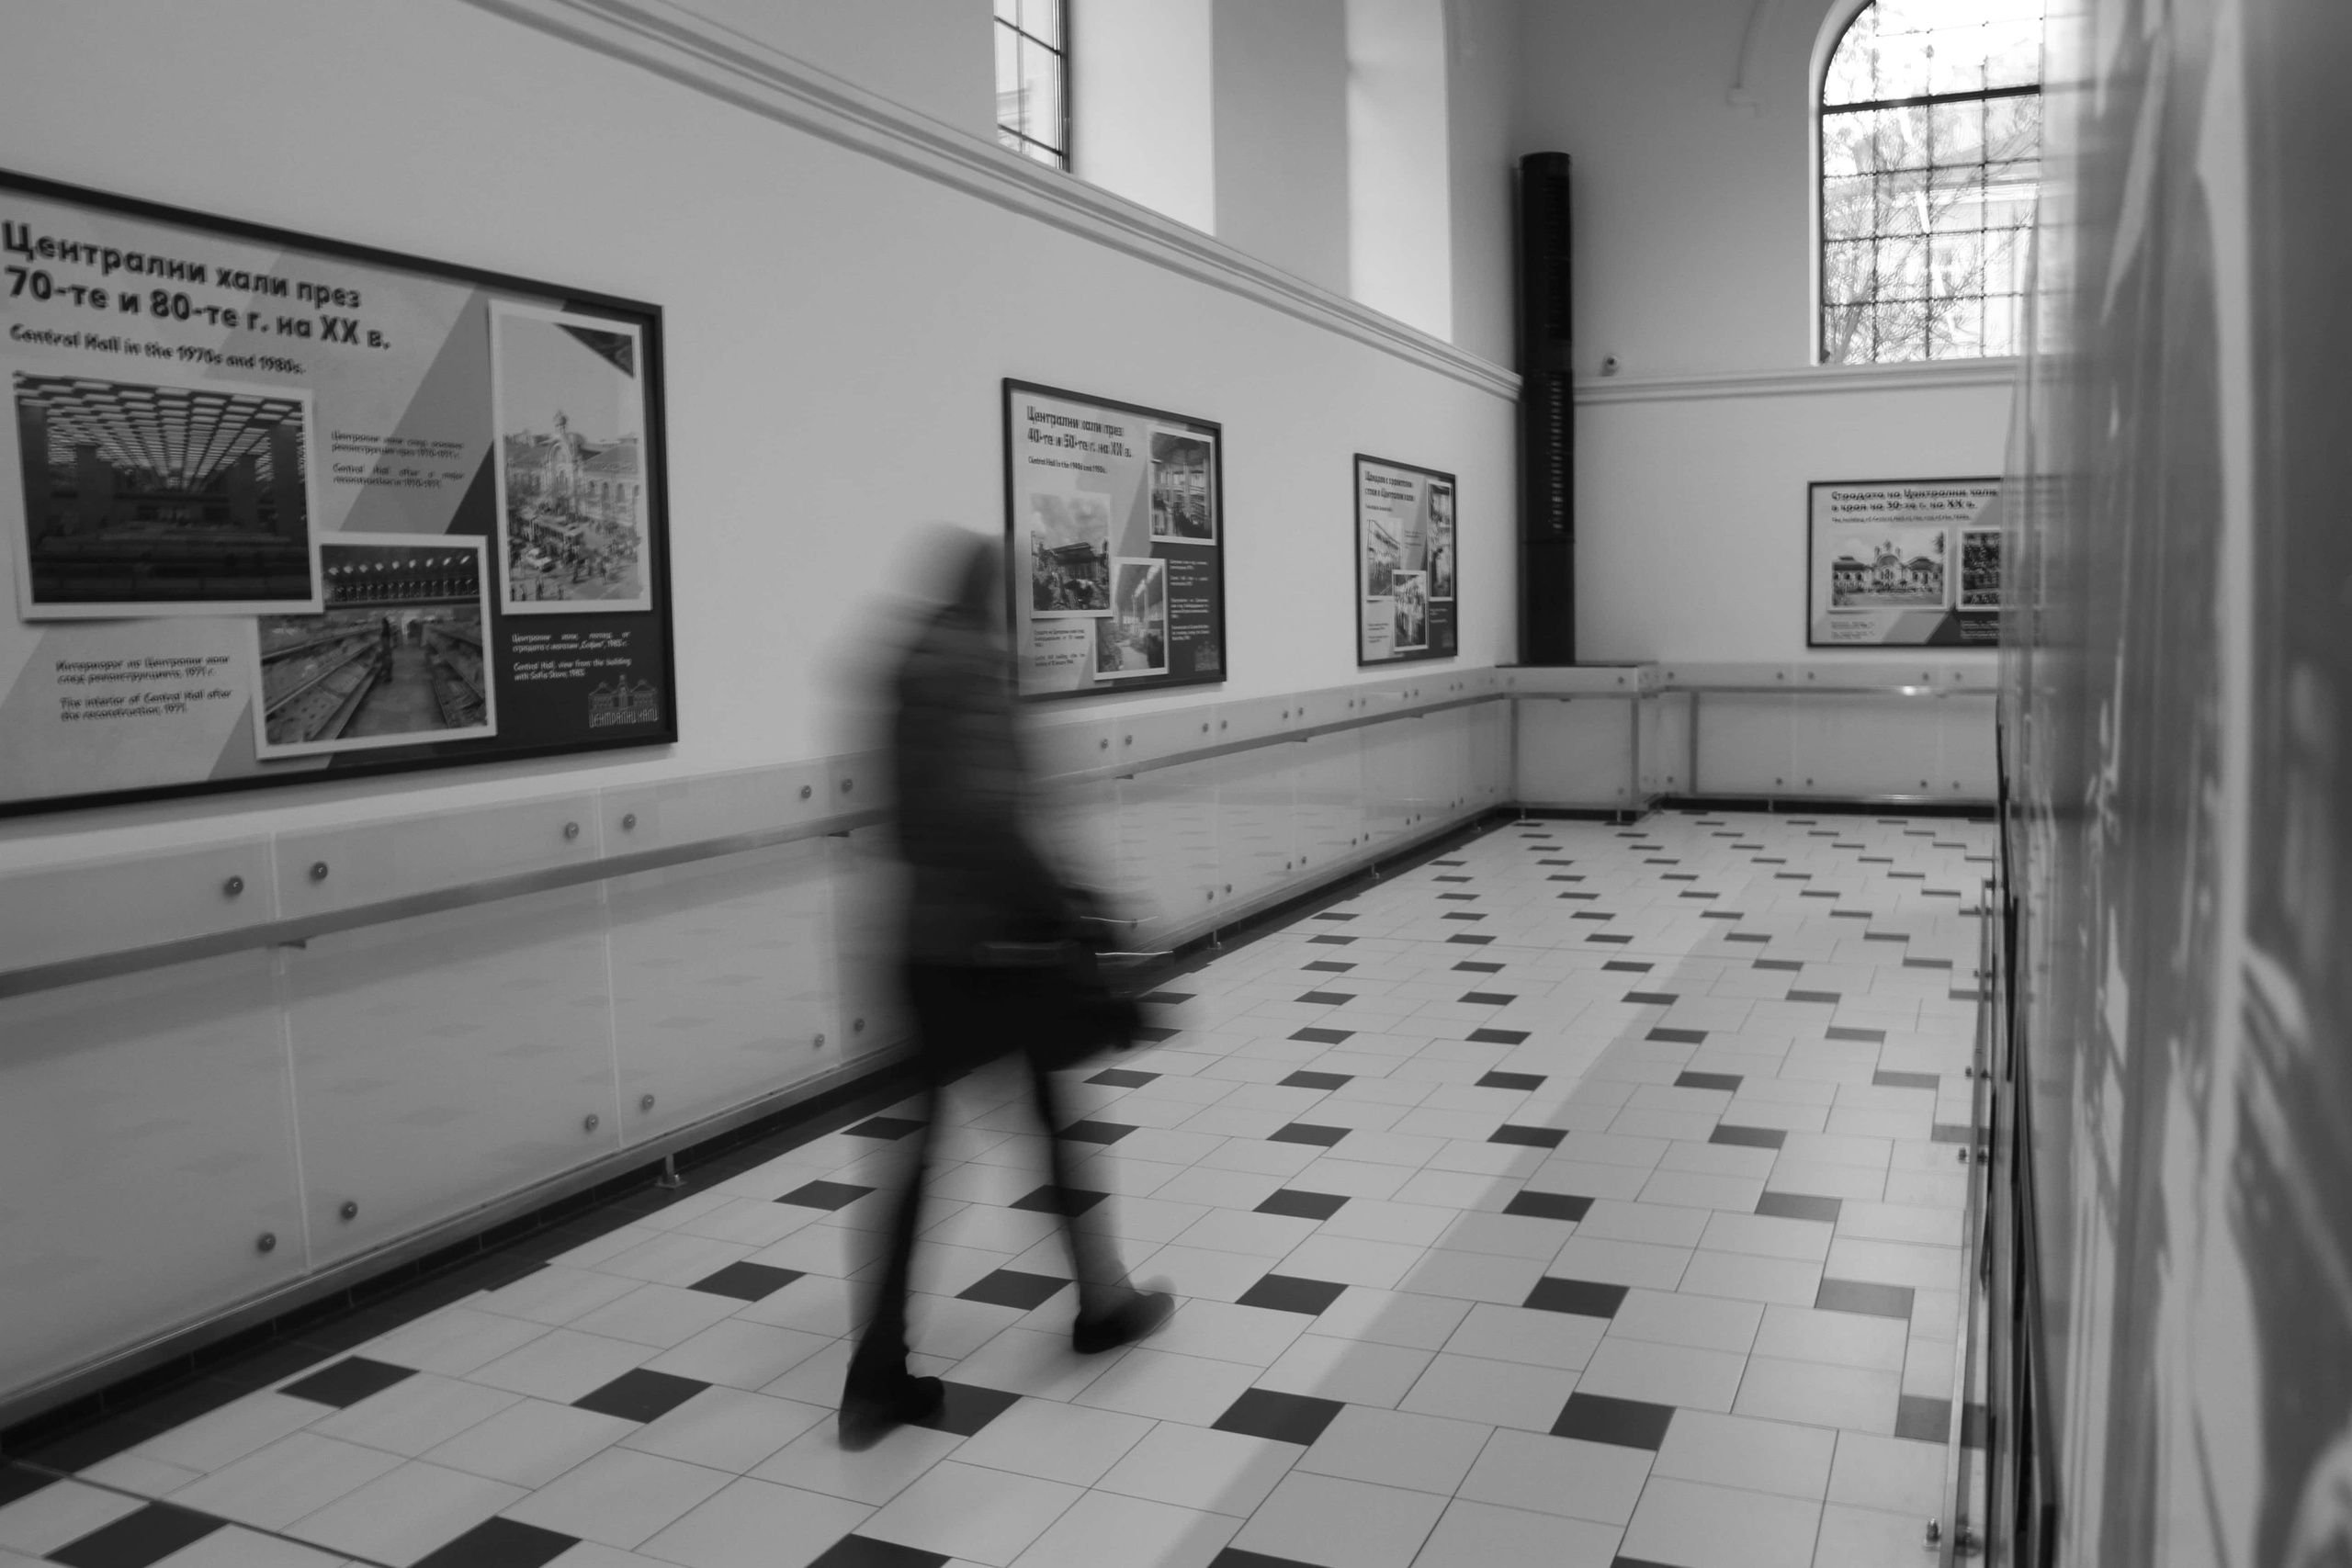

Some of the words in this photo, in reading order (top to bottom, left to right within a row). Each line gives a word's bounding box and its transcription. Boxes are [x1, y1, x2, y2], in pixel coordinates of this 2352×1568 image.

[2, 220, 207, 284] Централни
[216, 266, 288, 298] хали
[297, 279, 360, 309] през
[5, 265, 107, 309] 70-те
[119, 293, 139, 313] и
[150, 289, 239, 328] 80-те
[247, 310, 269, 333] г.
[277, 316, 311, 337] на
[368, 329, 391, 350] в.
[9, 323, 80, 348] Central
[85, 333, 121, 355] Hall
[124, 338, 141, 355] in
[145, 339, 174, 359] the
[177, 343, 224, 366] 1970s
[226, 355, 254, 369] and
[1027, 406, 1079, 429] Централни
[1080, 421, 1102, 433] хали
[1103, 424, 1124, 438] през
[1027, 427, 1053, 446] 40-те
[1056, 436, 1061, 447] и
[1063, 434, 1088, 451] 50-те
[1090, 442, 1096, 452] г.
[1098, 445, 1109, 455] на
[1124, 447, 1132, 457] в.
[333, 462, 365, 474] Central
[372, 465, 390, 476] Hall
[399, 467, 420, 477] after
[427, 469, 435, 479] a
[442, 470, 465, 481] major
[1831, 491, 1883, 502] Сградата
[1904, 489, 1966, 500] Централни
[1970, 489, 1998, 498] хали
[514, 661, 537, 672] Central
[558, 660, 574, 670] view
[575, 658, 592, 668] from
[593, 657, 605, 668] the
[605, 656, 632, 668] building
[60, 696, 82, 710] The
[85, 694, 126, 708] interior
[129, 693, 141, 705] of
[143, 691, 181, 705] Central
[184, 689, 204, 701] Hall
[207, 688, 233, 701] after
[61, 711, 82, 723] the
